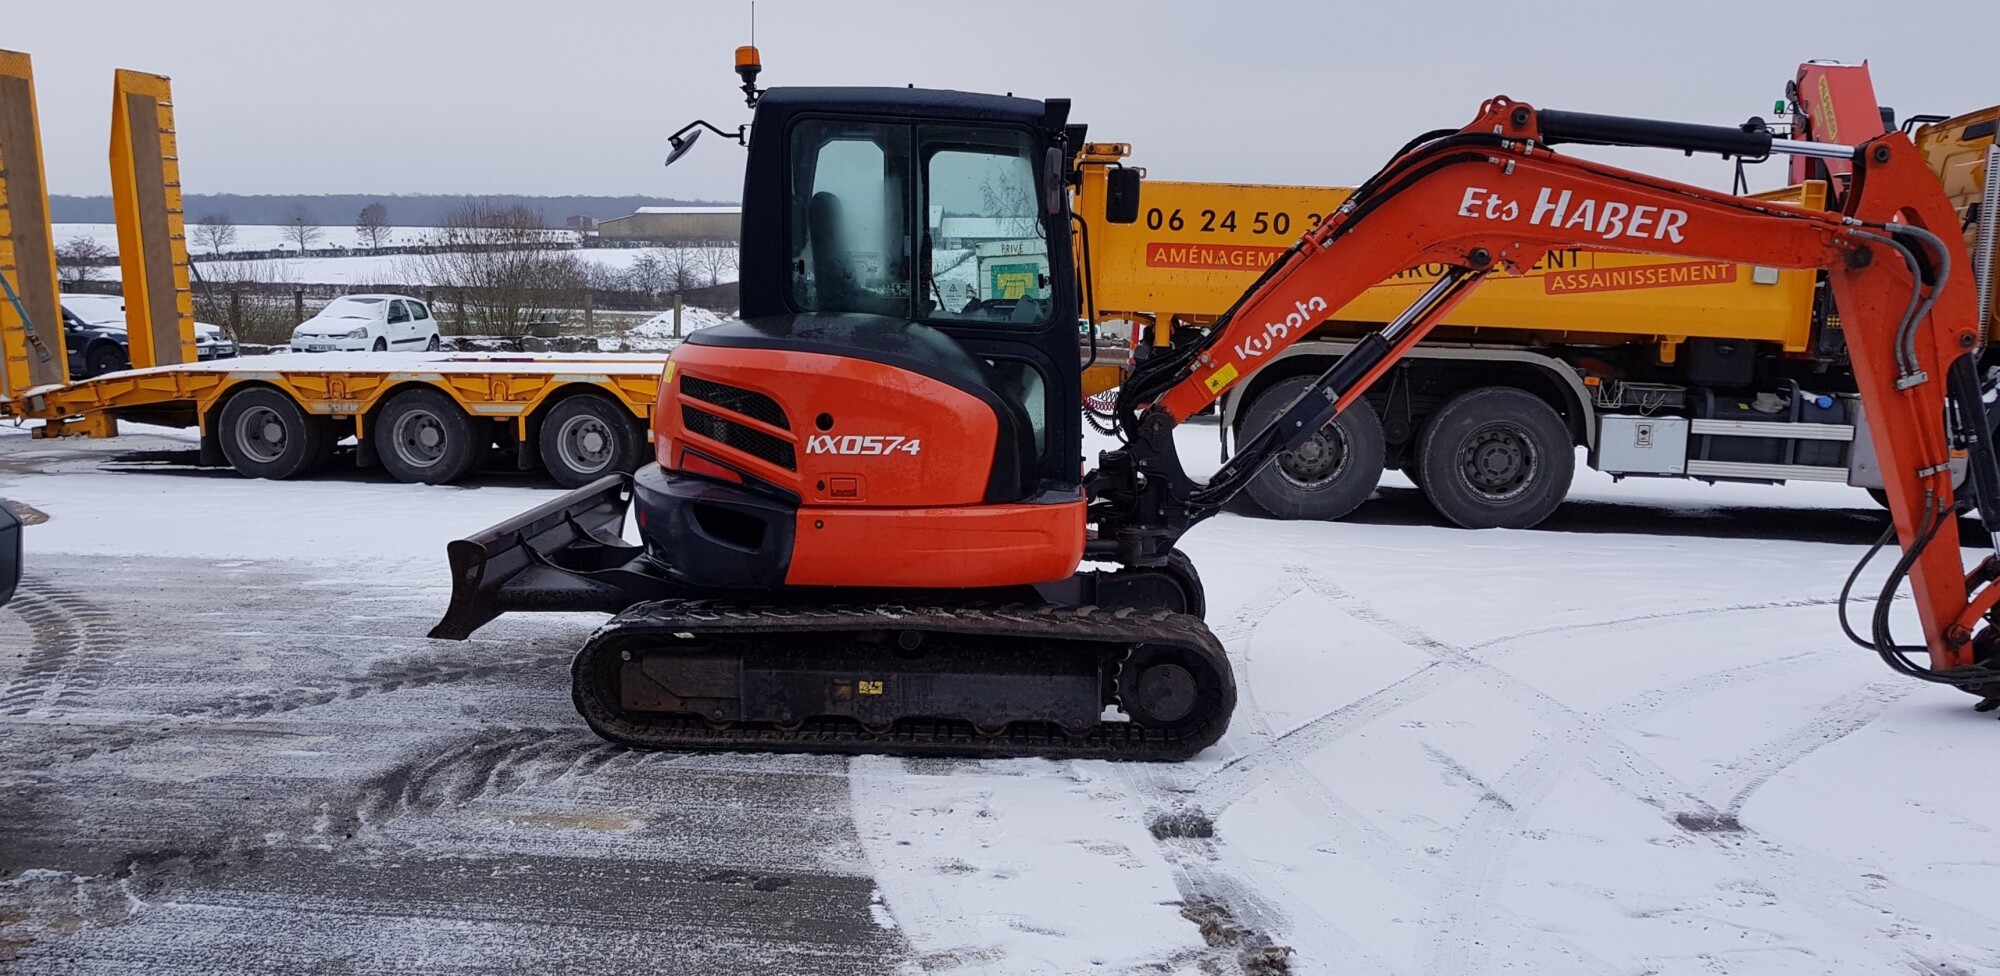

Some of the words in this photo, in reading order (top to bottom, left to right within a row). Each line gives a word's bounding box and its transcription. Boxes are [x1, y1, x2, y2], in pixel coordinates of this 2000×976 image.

[1146, 207, 1184, 232] 06
[1199, 209, 1237, 232] 24
[1252, 212, 1290, 235] 50
[1458, 187, 1519, 221] Ets
[1529, 187, 1689, 244] HABER
[1551, 264, 1731, 291] ASSAINISSEMENT
[1233, 296, 1328, 361] Kubota
